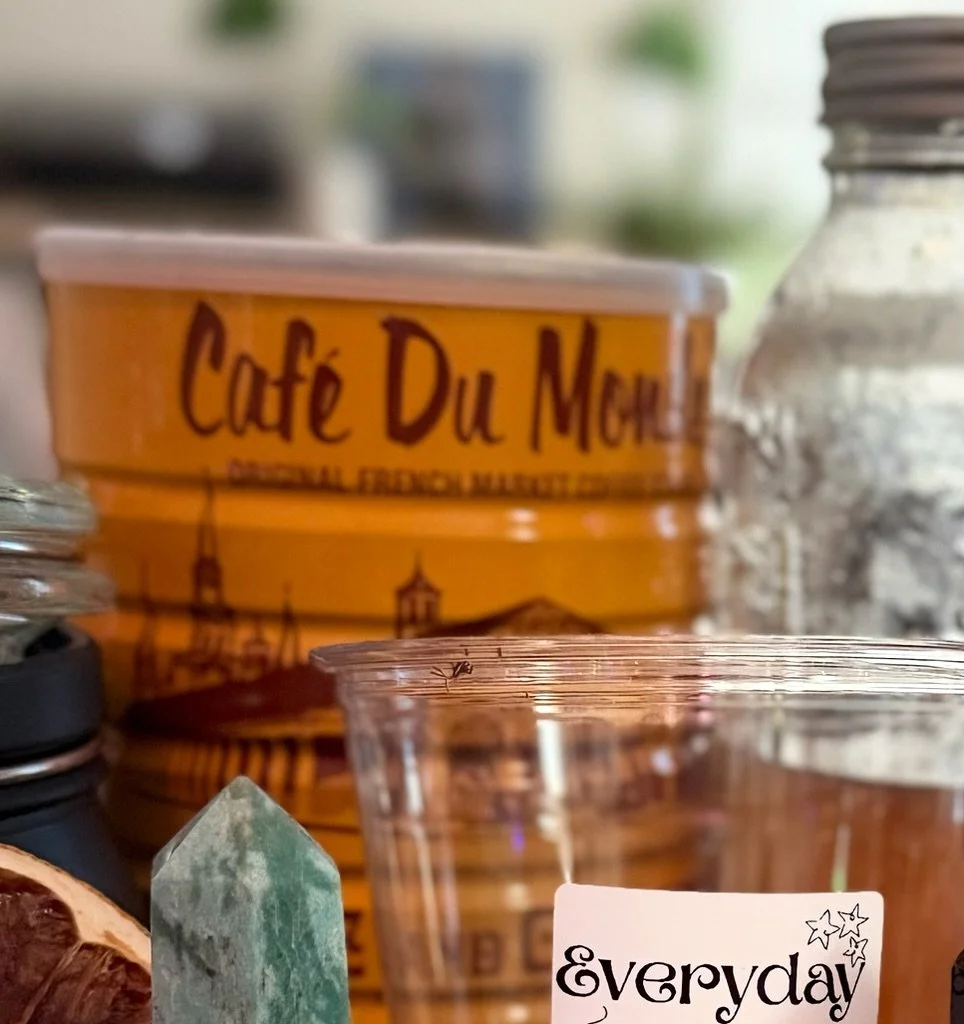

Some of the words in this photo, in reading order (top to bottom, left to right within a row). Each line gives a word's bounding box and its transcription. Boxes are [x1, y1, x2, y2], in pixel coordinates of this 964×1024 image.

[179, 299, 352, 446] Café
[381, 314, 504, 448] Du
[555, 944, 866, 1024] Everyday
